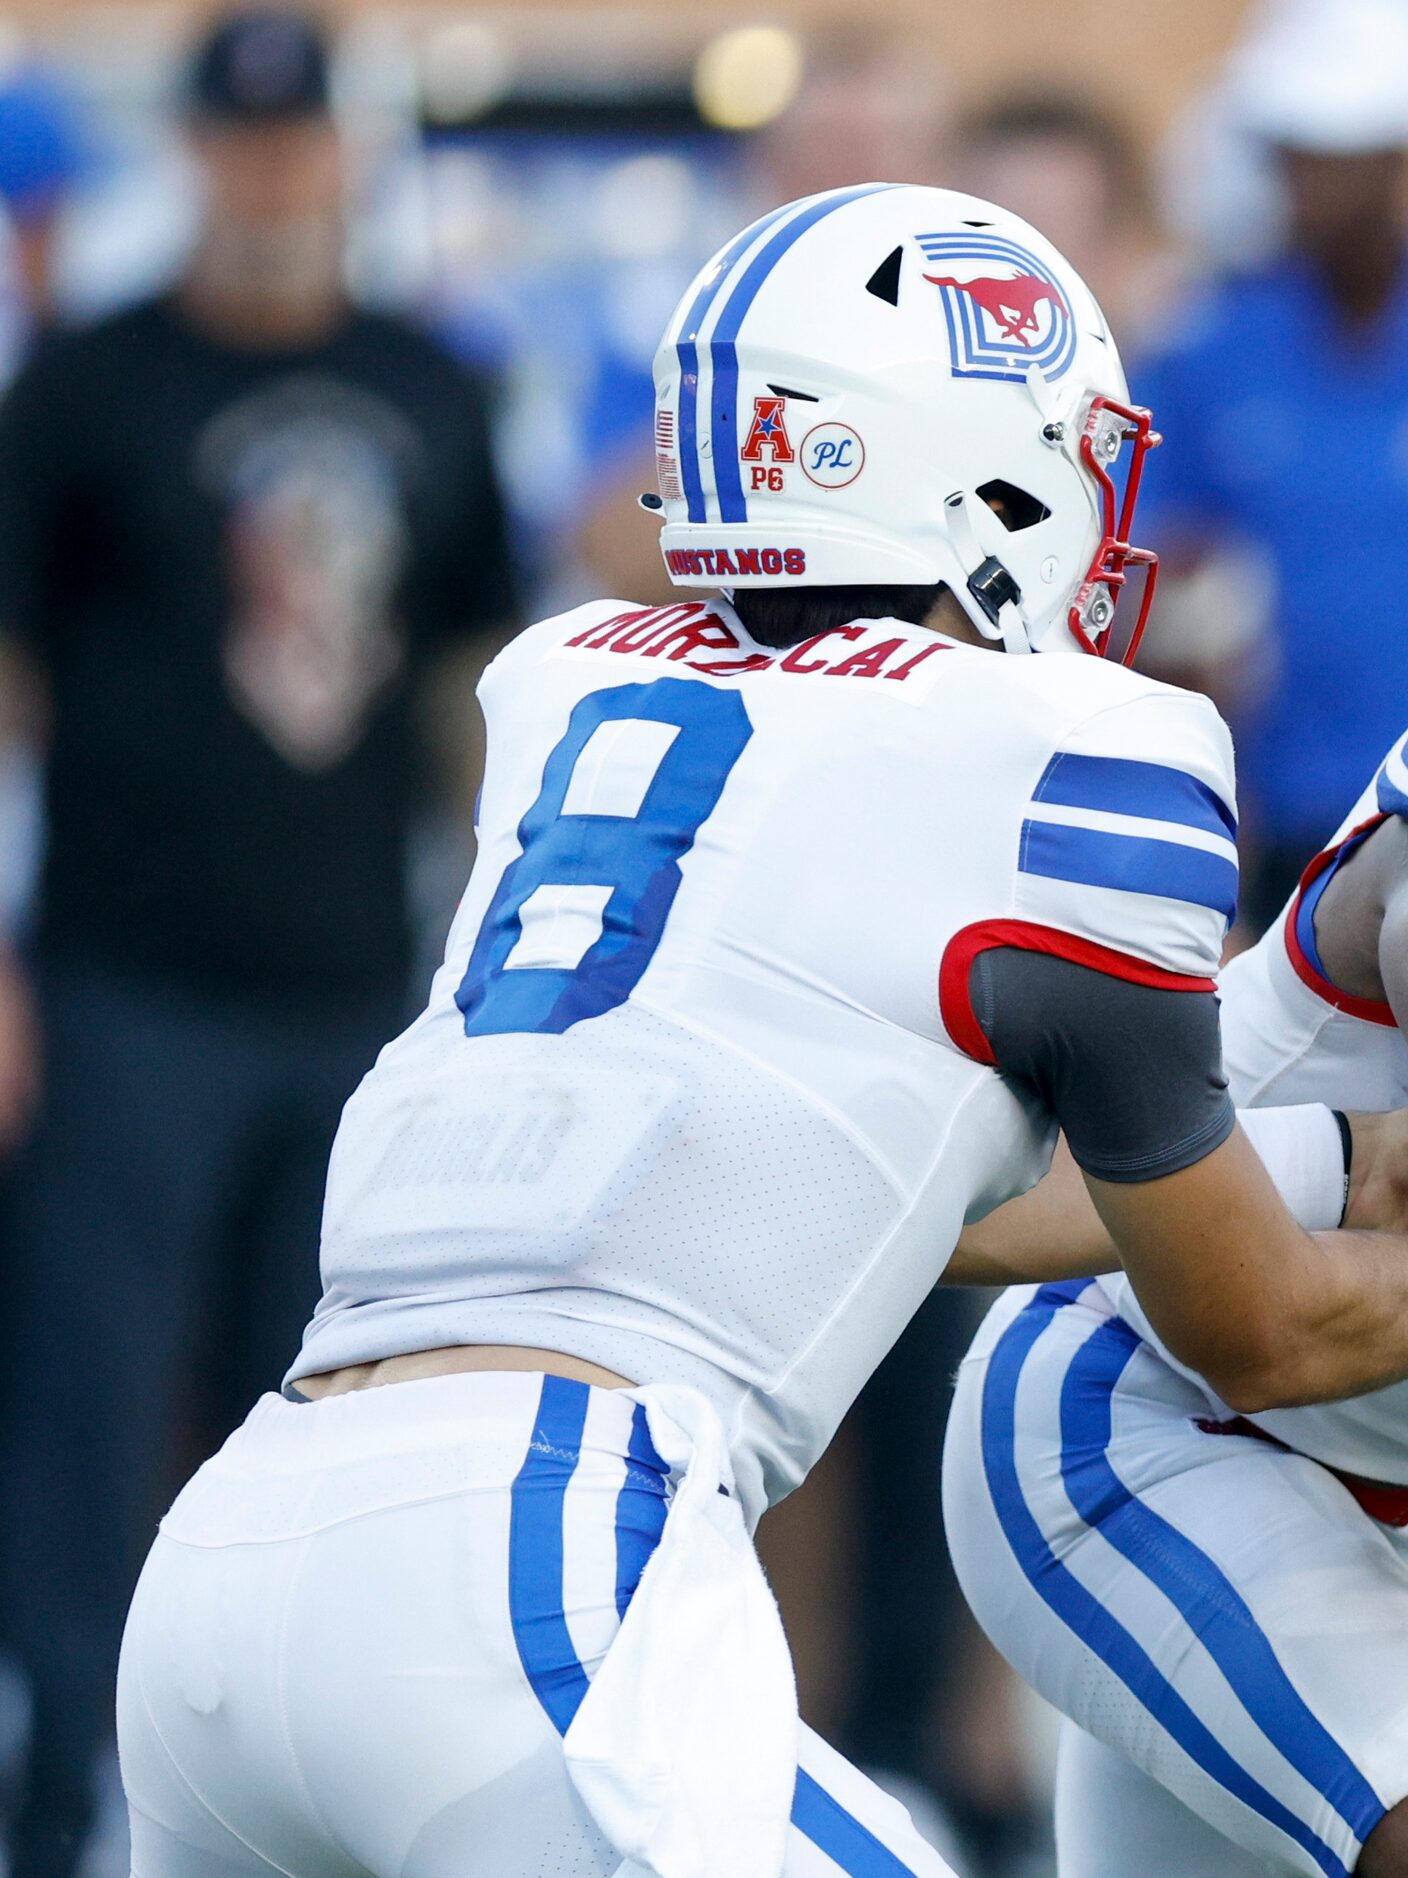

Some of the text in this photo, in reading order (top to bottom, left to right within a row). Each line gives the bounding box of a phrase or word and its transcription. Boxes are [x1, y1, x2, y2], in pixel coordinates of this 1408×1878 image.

[811, 439, 853, 470] PL
[751, 467, 783, 491] P6
[665, 549, 806, 576] MUSTANGS
[454, 677, 755, 1037] 8
